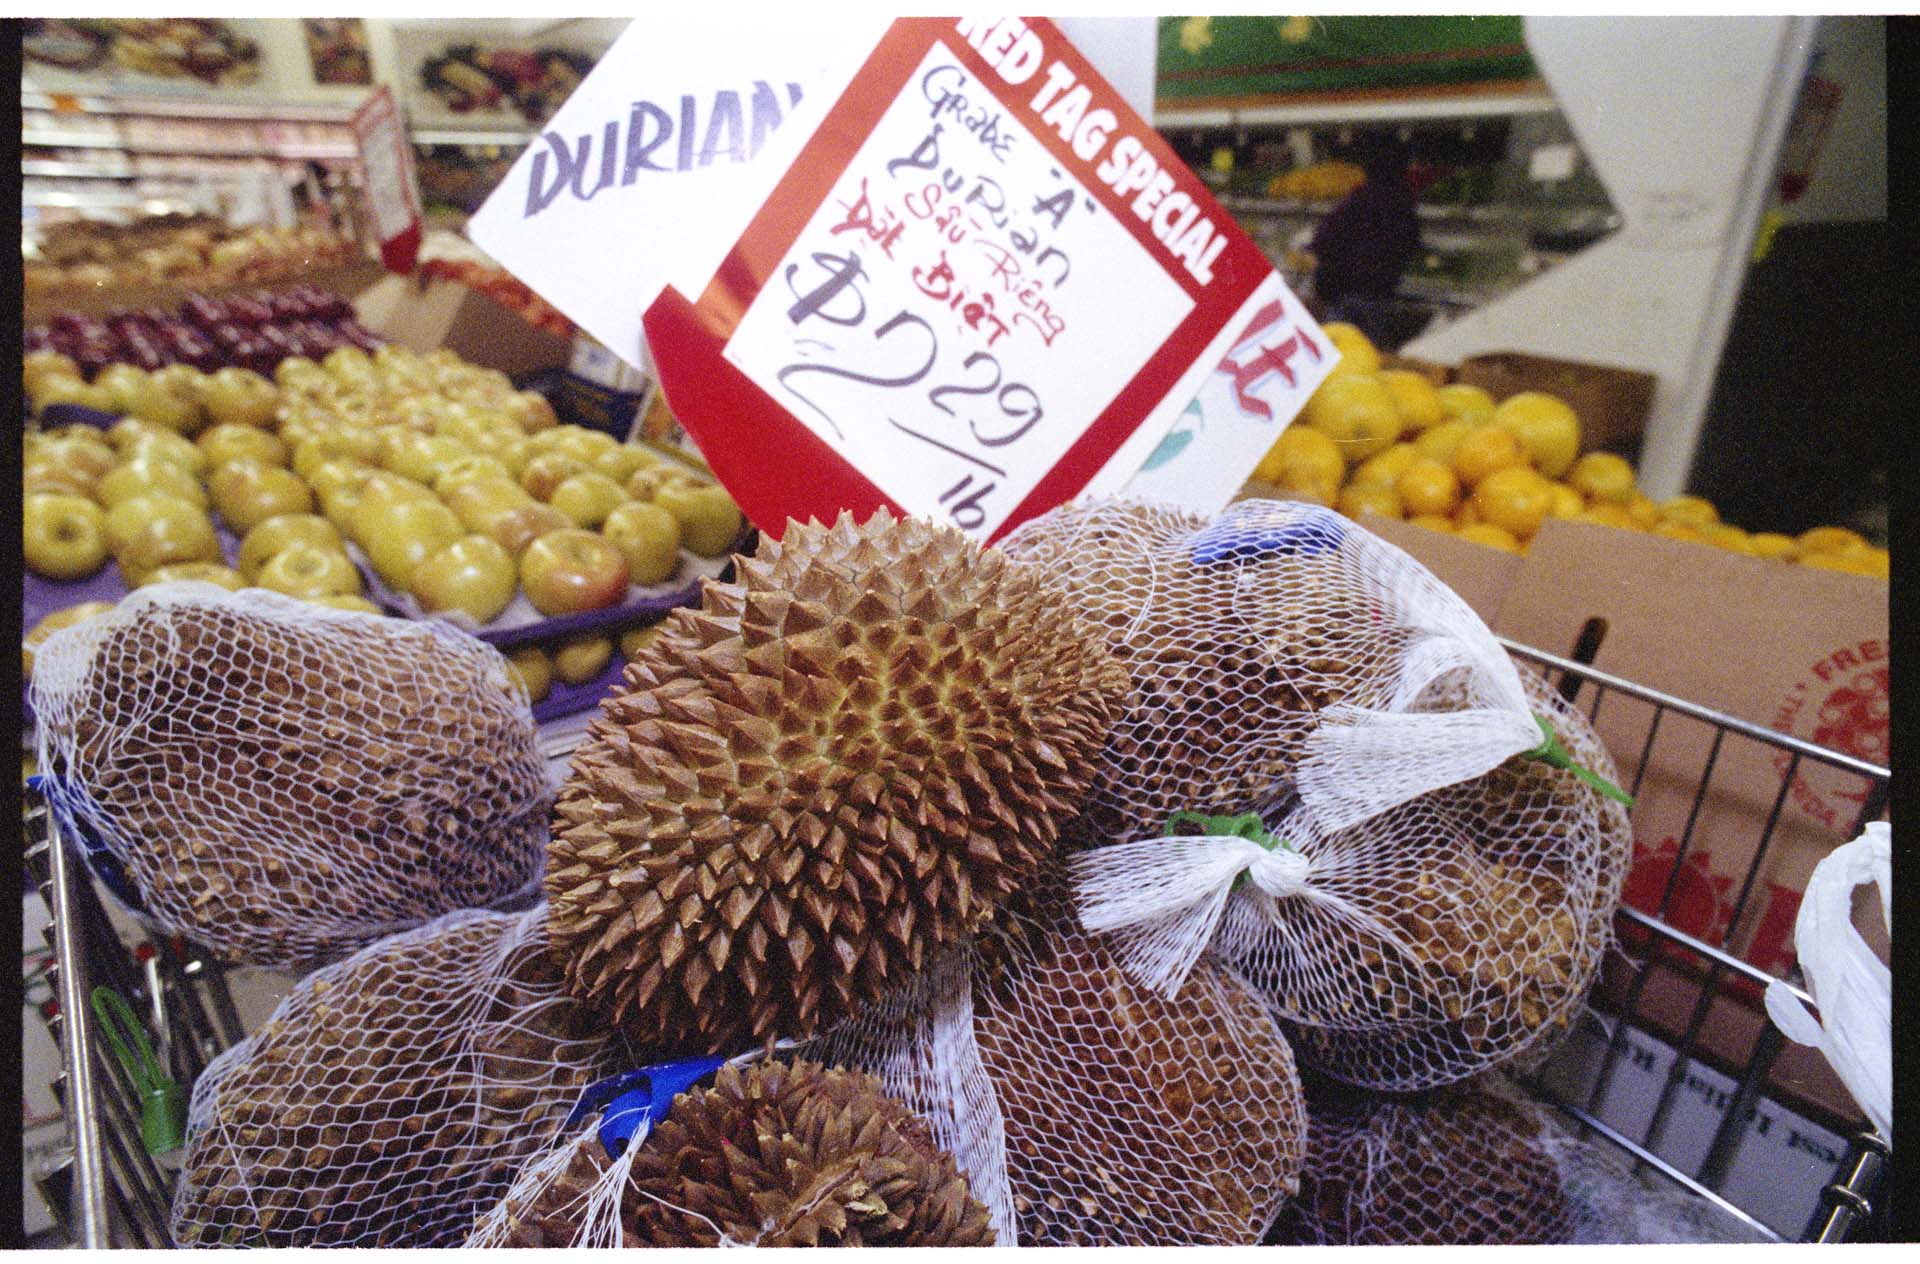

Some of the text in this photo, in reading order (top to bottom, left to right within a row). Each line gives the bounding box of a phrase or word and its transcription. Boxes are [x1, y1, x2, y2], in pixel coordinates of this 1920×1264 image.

[524, 79, 803, 219] DURIAN
[955, 17, 1228, 287] RED TAG SPECIAL
